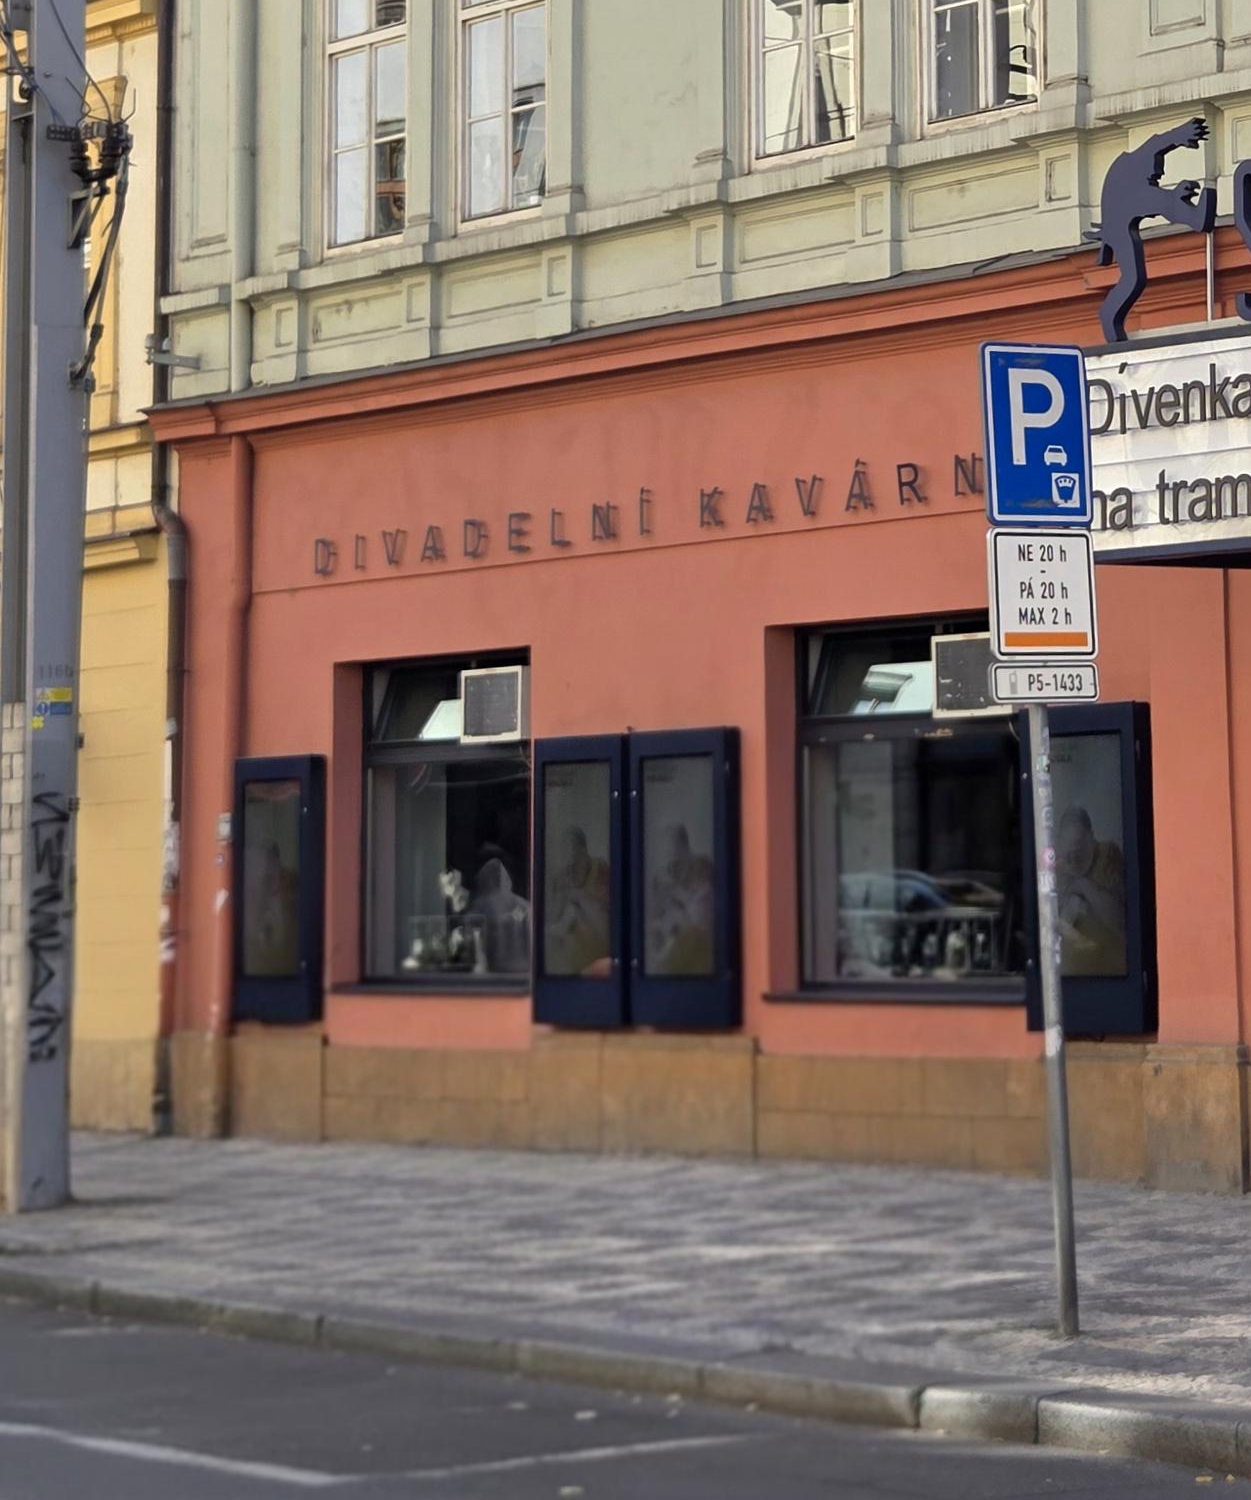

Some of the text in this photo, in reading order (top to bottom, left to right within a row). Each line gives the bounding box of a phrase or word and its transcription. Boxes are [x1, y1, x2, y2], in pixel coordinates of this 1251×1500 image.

[1008, 368, 1065, 465] P
[315, 451, 984, 577] DIVADELNÍ KAVÁRN
[1018, 544, 1067, 562] NE 20 h
[1020, 577, 1068, 599] PÁ 20 h
[1019, 607, 1072, 625] MAX 2 h
[1028, 674, 1083, 692] P5-1433
